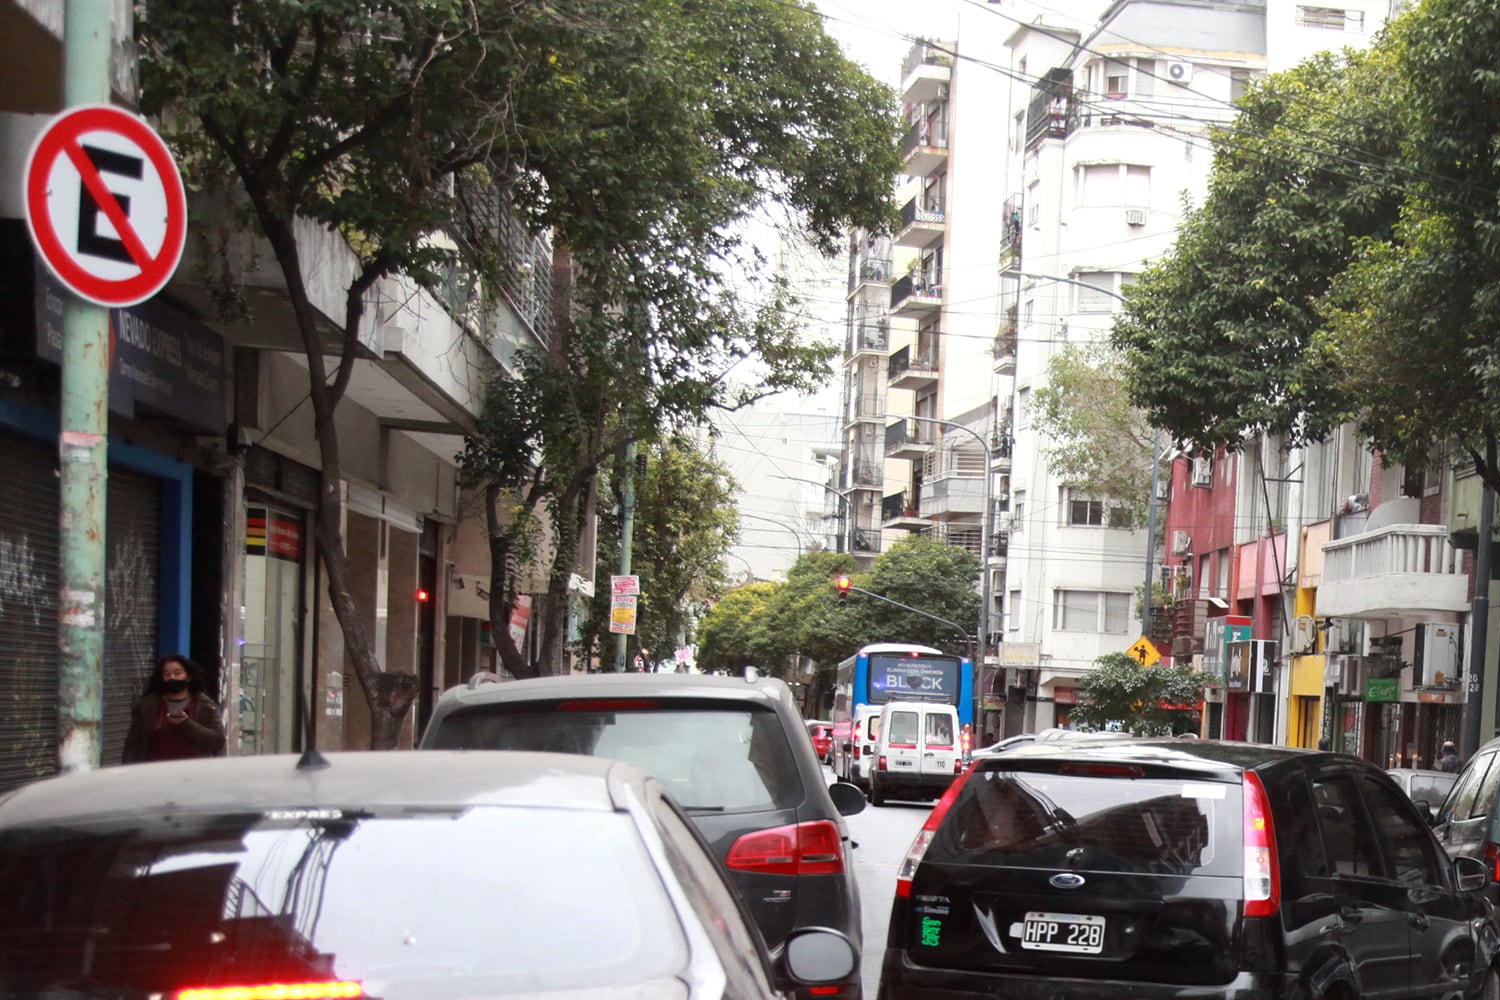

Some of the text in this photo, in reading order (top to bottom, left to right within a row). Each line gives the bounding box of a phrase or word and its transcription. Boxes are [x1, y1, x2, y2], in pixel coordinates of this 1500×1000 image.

[77, 144, 143, 265] E
[1025, 921, 1101, 946] HPP 228
